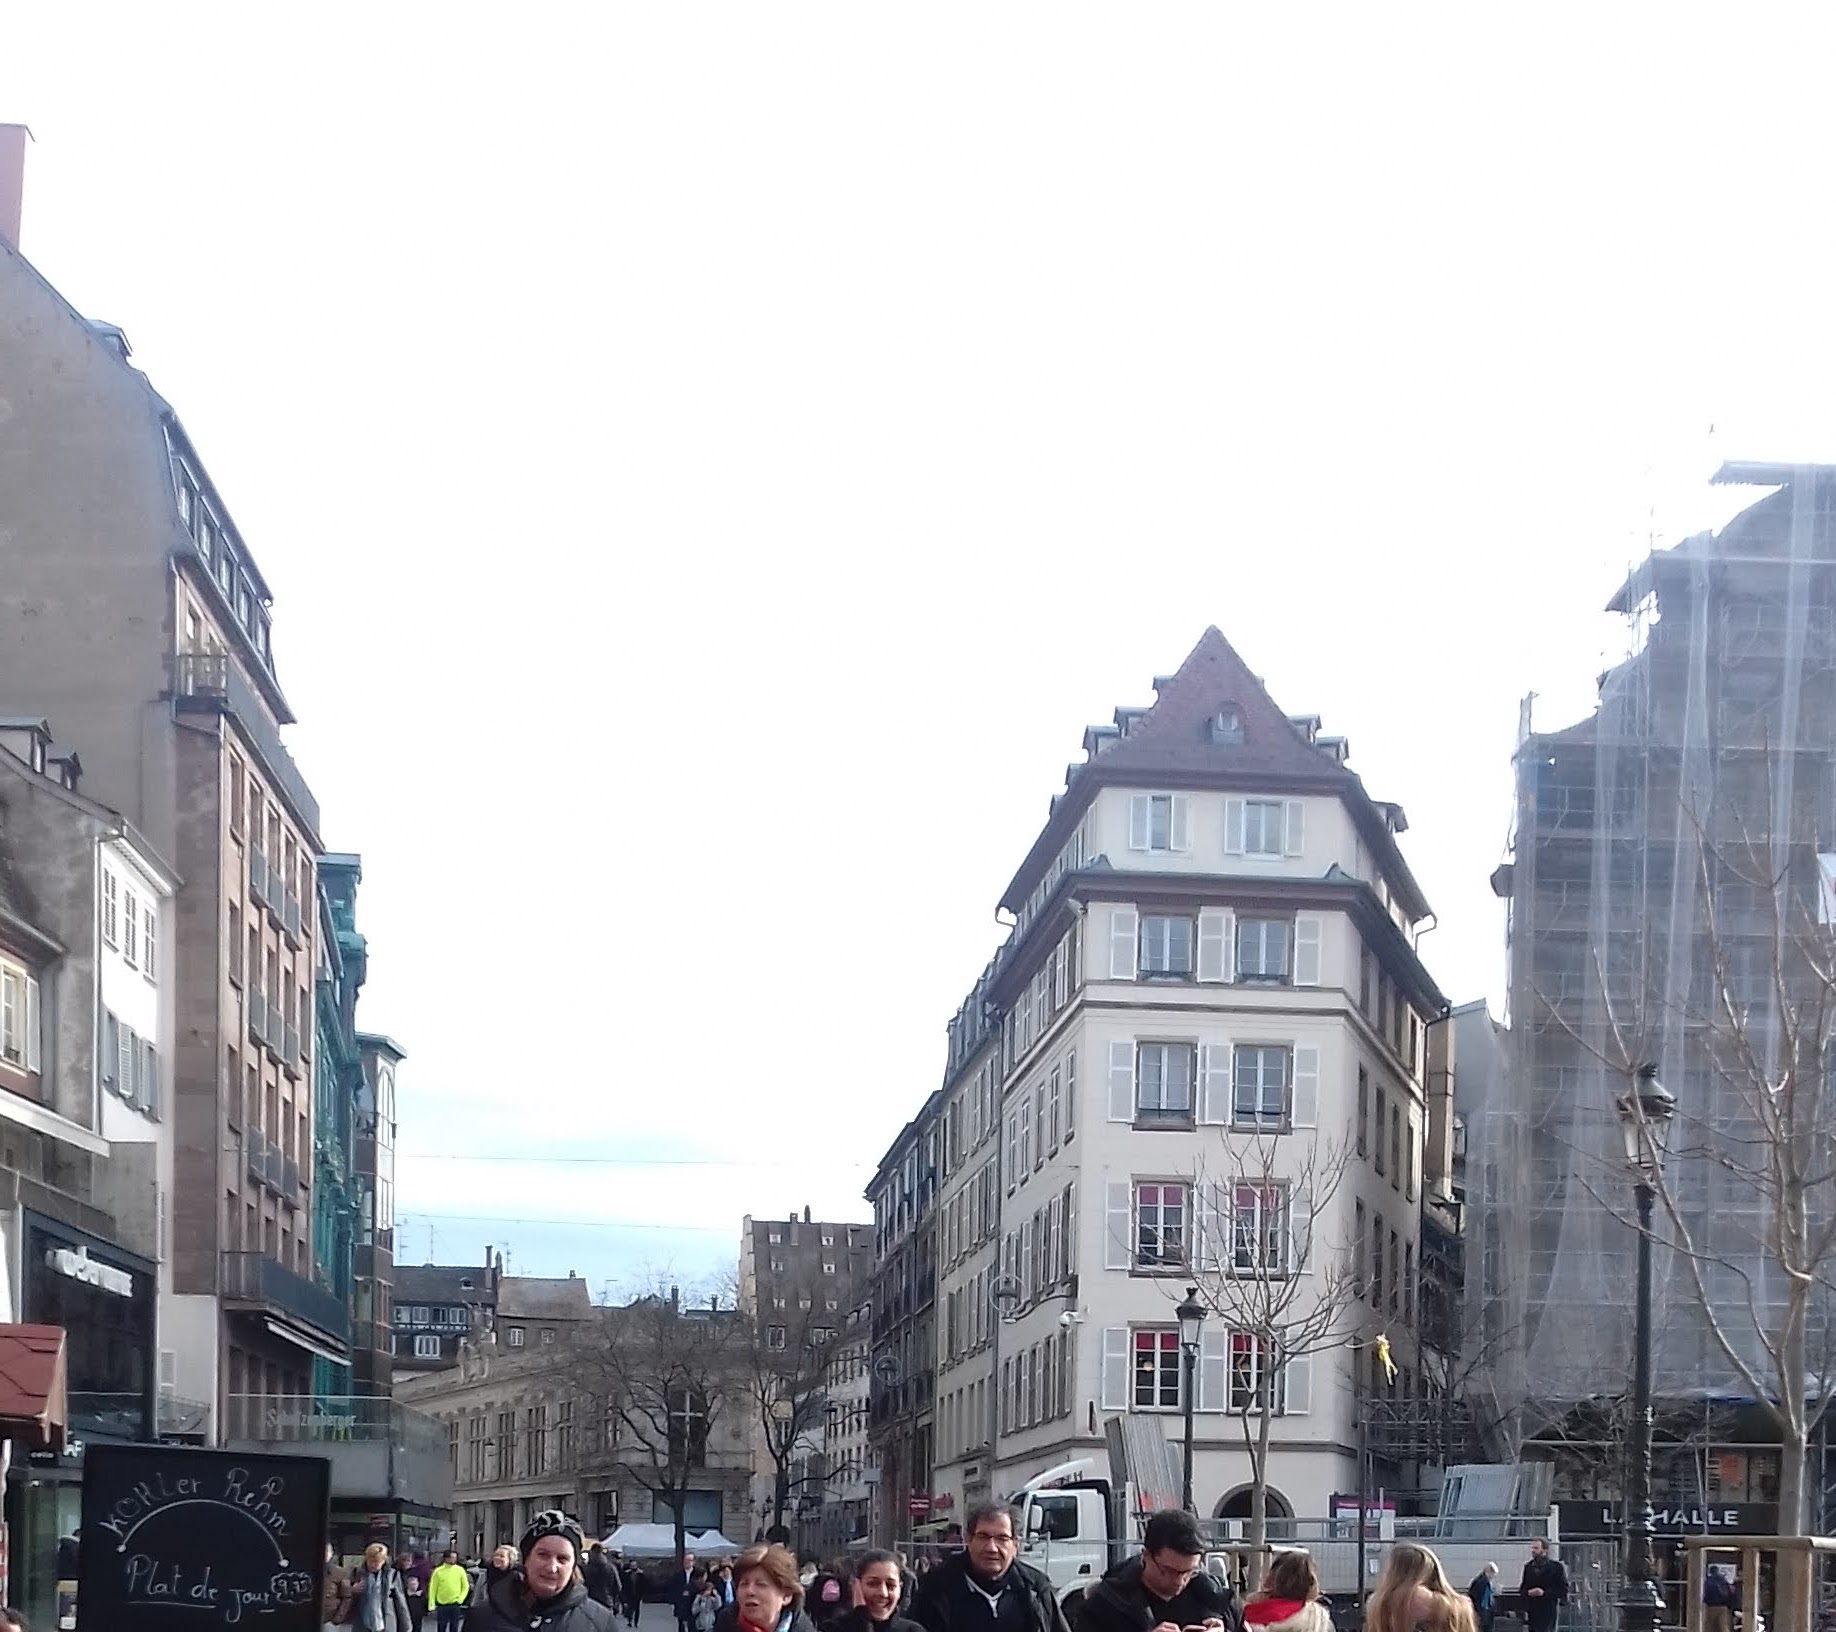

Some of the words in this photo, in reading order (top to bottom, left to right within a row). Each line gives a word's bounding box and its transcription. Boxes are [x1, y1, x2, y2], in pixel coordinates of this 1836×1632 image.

[1650, 1509, 1739, 1526] HALLE
[127, 1554, 182, 1595] Plat
[190, 1565, 219, 1601] de
